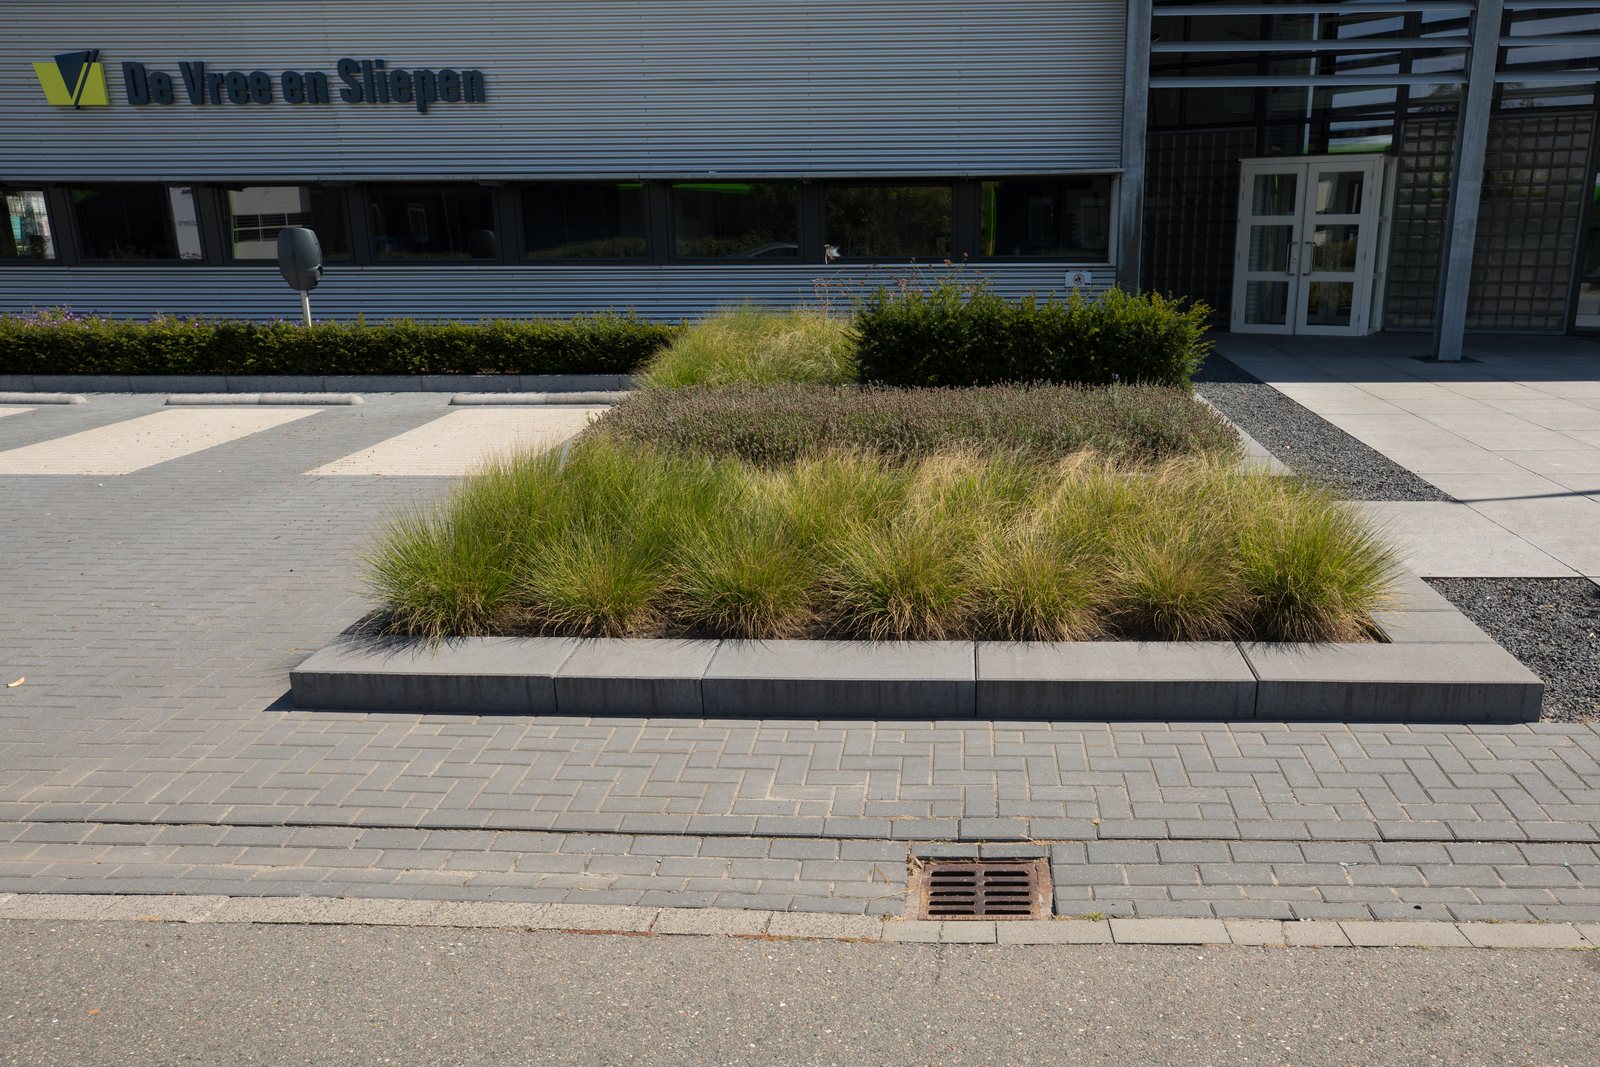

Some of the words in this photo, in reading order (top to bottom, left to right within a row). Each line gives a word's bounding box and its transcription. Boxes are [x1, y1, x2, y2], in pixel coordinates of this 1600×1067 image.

[122, 61, 173, 105] De
[178, 60, 273, 105] Vree
[281, 69, 330, 105] en
[336, 58, 486, 113] Sliepen
